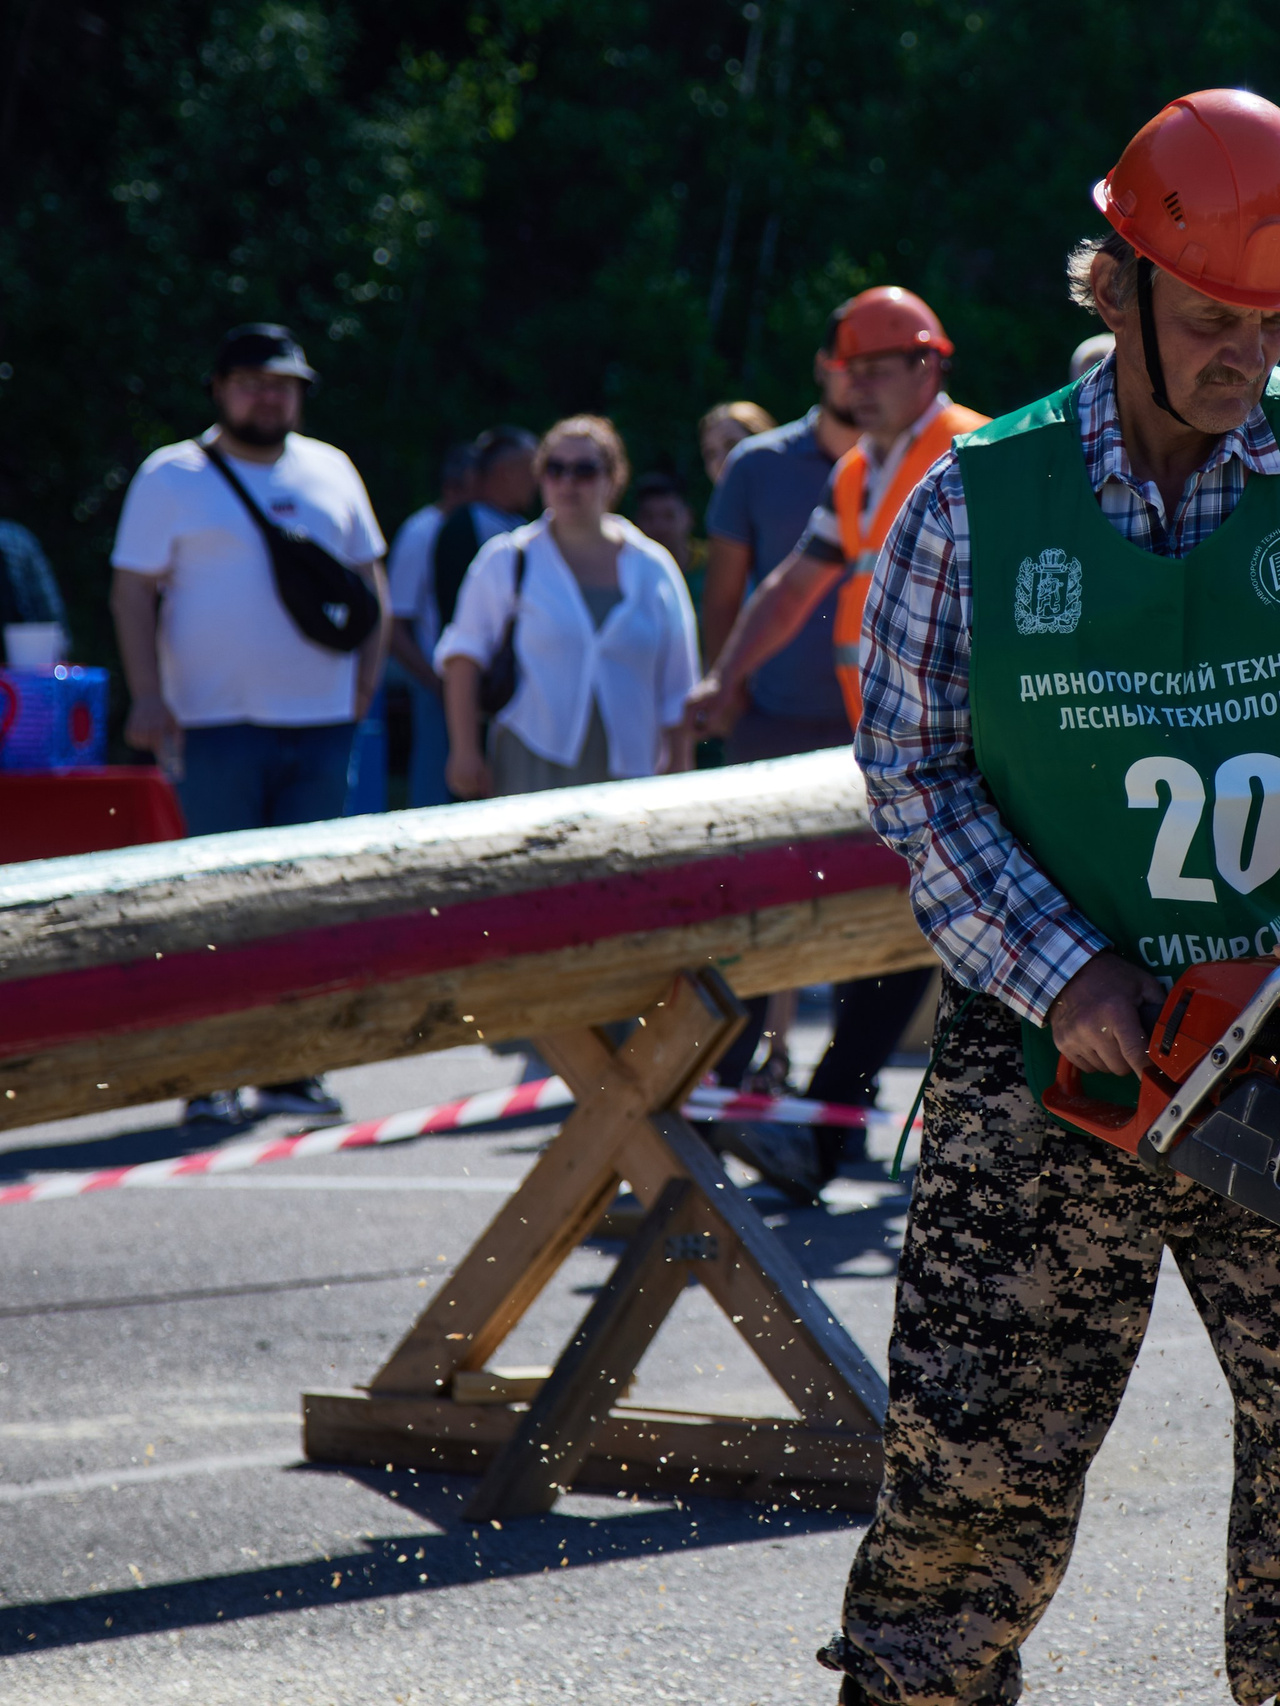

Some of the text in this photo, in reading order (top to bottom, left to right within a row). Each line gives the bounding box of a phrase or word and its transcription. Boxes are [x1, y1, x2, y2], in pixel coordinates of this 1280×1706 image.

[1250, 545, 1272, 606] ДИВНОГОРСКИЙ
[1020, 663, 1216, 702] ДИВНОГОРСКИЙ
[1060, 704, 1161, 731] ЛЕСНЫХ
